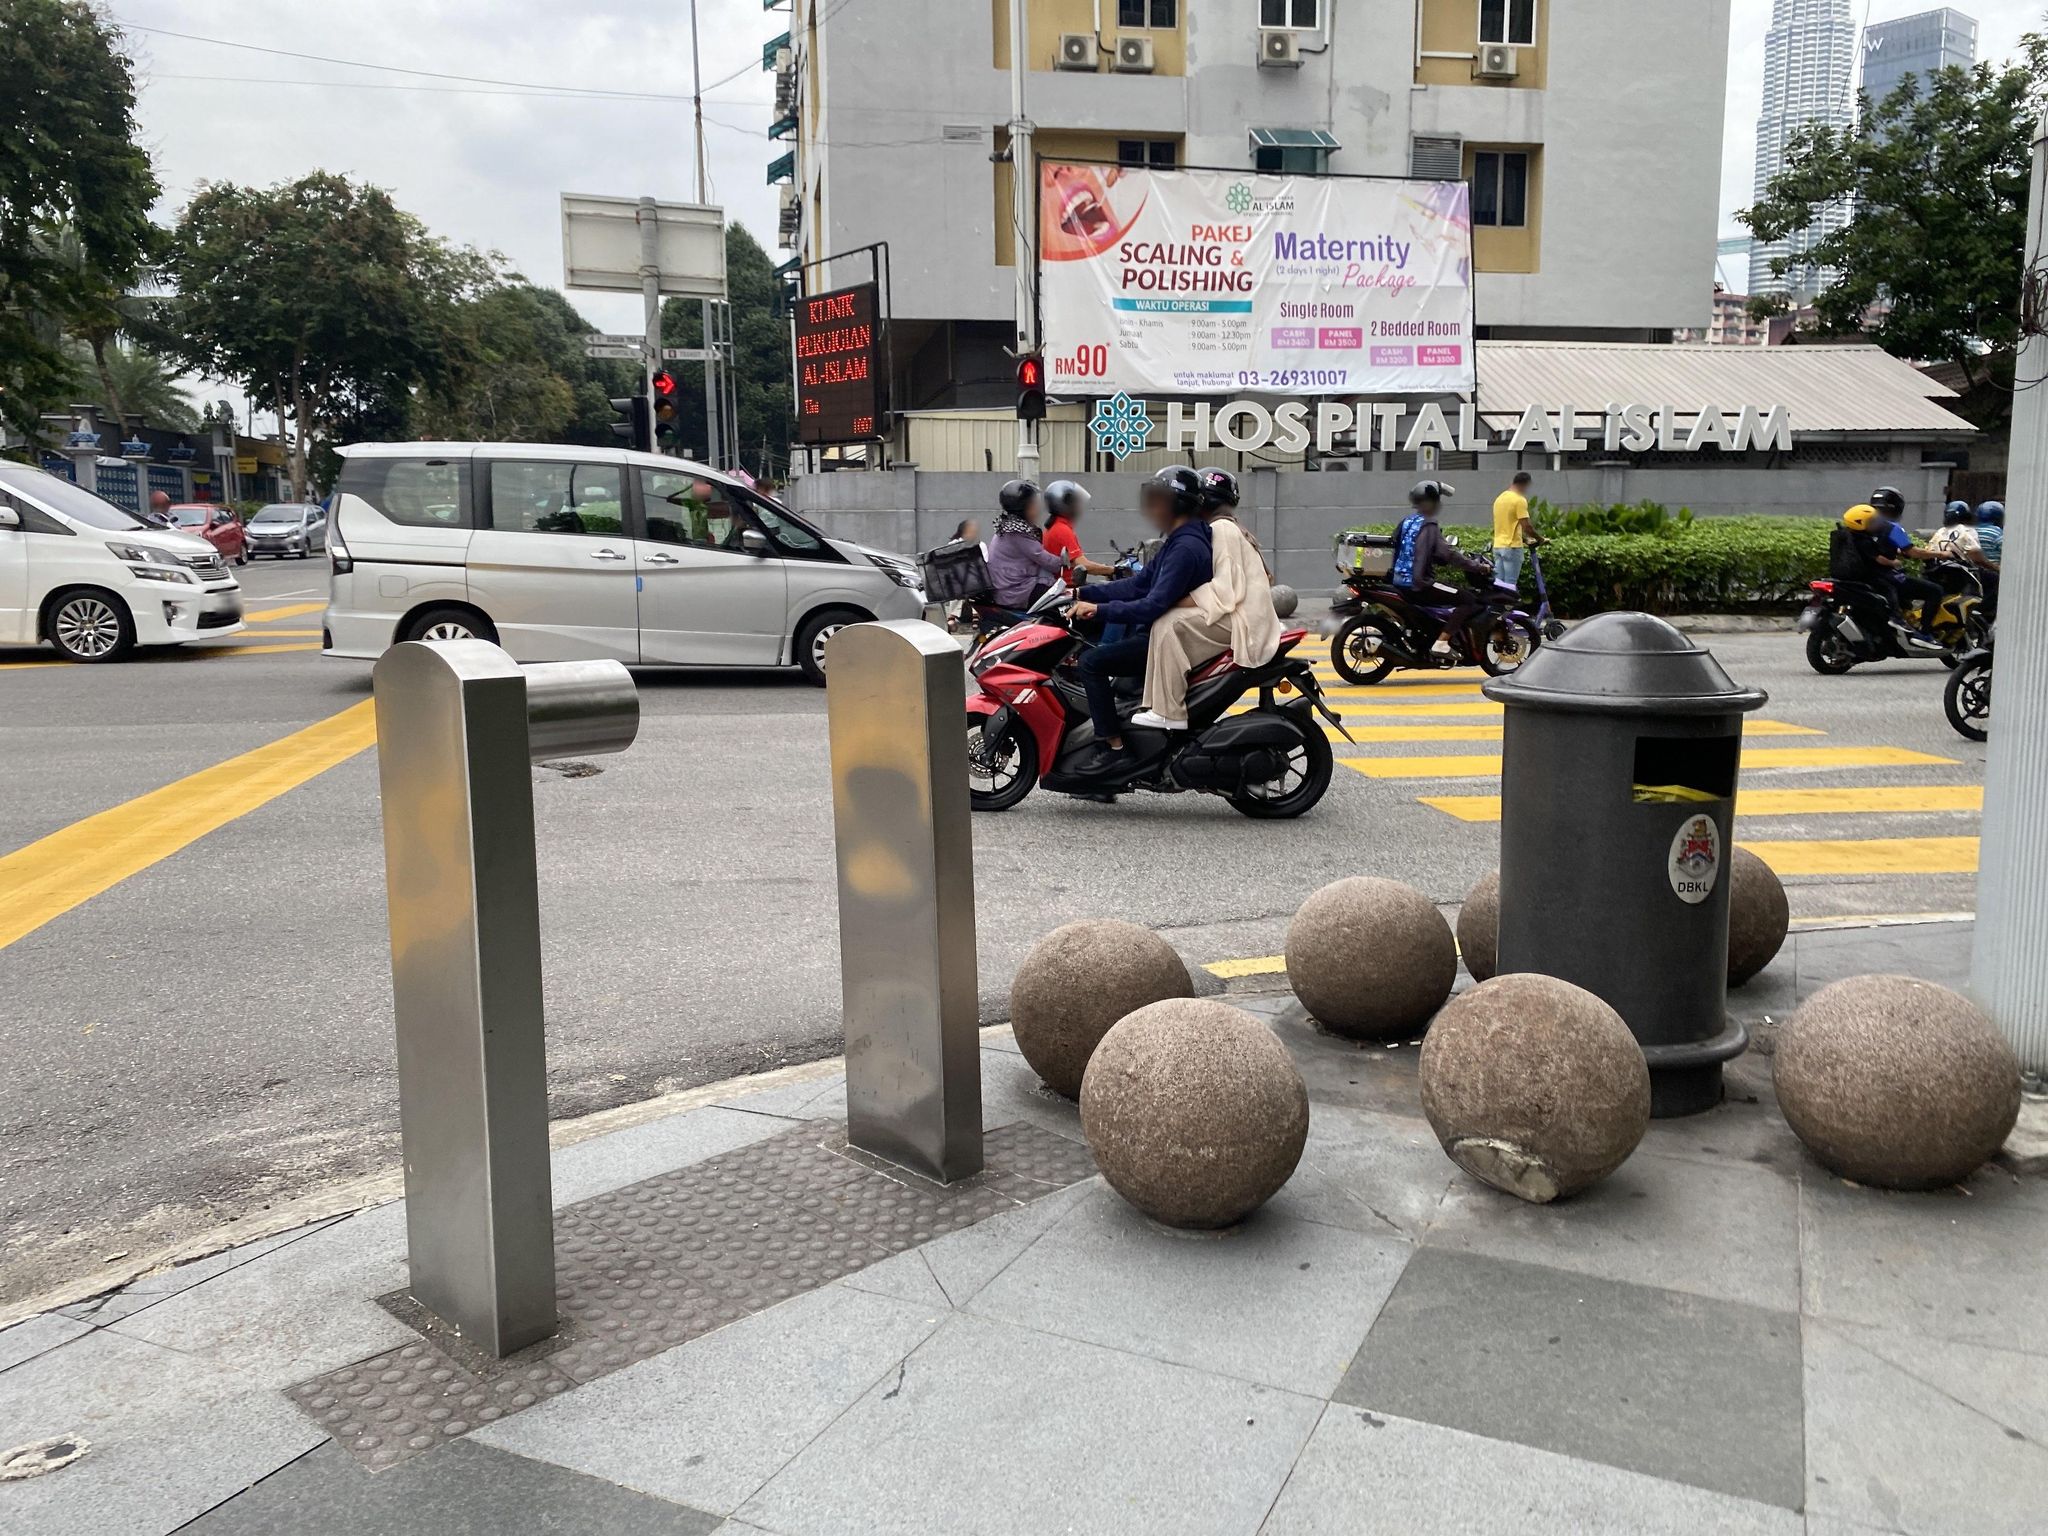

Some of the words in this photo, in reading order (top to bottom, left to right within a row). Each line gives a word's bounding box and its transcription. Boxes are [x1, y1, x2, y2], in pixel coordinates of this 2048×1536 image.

[1866, 38, 1884, 52] W
[1252, 202, 1264, 211] AL
[1191, 224, 1252, 242] PAKEJ
[1120, 242, 1222, 266] SCALING
[1230, 250, 1244, 266] &
[1275, 232, 1411, 269] Maternity
[1287, 265, 1308, 278] days
[1315, 264, 1340, 277] night)
[1122, 269, 1253, 292] POLISHING
[1342, 263, 1416, 298] Package
[1135, 300, 1170, 310] WAKTU
[1171, 301, 1210, 312] OPERASI
[1280, 302, 1318, 320] Single
[1320, 302, 1354, 318] Room
[1191, 320, 1216, 328] 9.00am
[1222, 320, 1247, 330] 5.00pm
[1371, 322, 1378, 336] 2
[1380, 320, 1424, 336] Bedded
[1427, 320, 1460, 336] Room
[1191, 331, 1216, 340] 9.00am
[1222, 331, 1251, 341] 12.30pm
[1328, 330, 1353, 338] PANEL
[1191, 342, 1216, 350] 9.00am
[1222, 342, 1248, 352] 5.00pm
[804, 356, 867, 386] AL-ISLAM
[1196, 371, 1234, 379] maklumat
[1238, 370, 1347, 386] 03-26931007
[1202, 379, 1233, 387] hubungi
[1166, 402, 1488, 453] HOSPITAL
[1508, 403, 1589, 453] AL
[1677, 882, 1709, 893] DBKL
